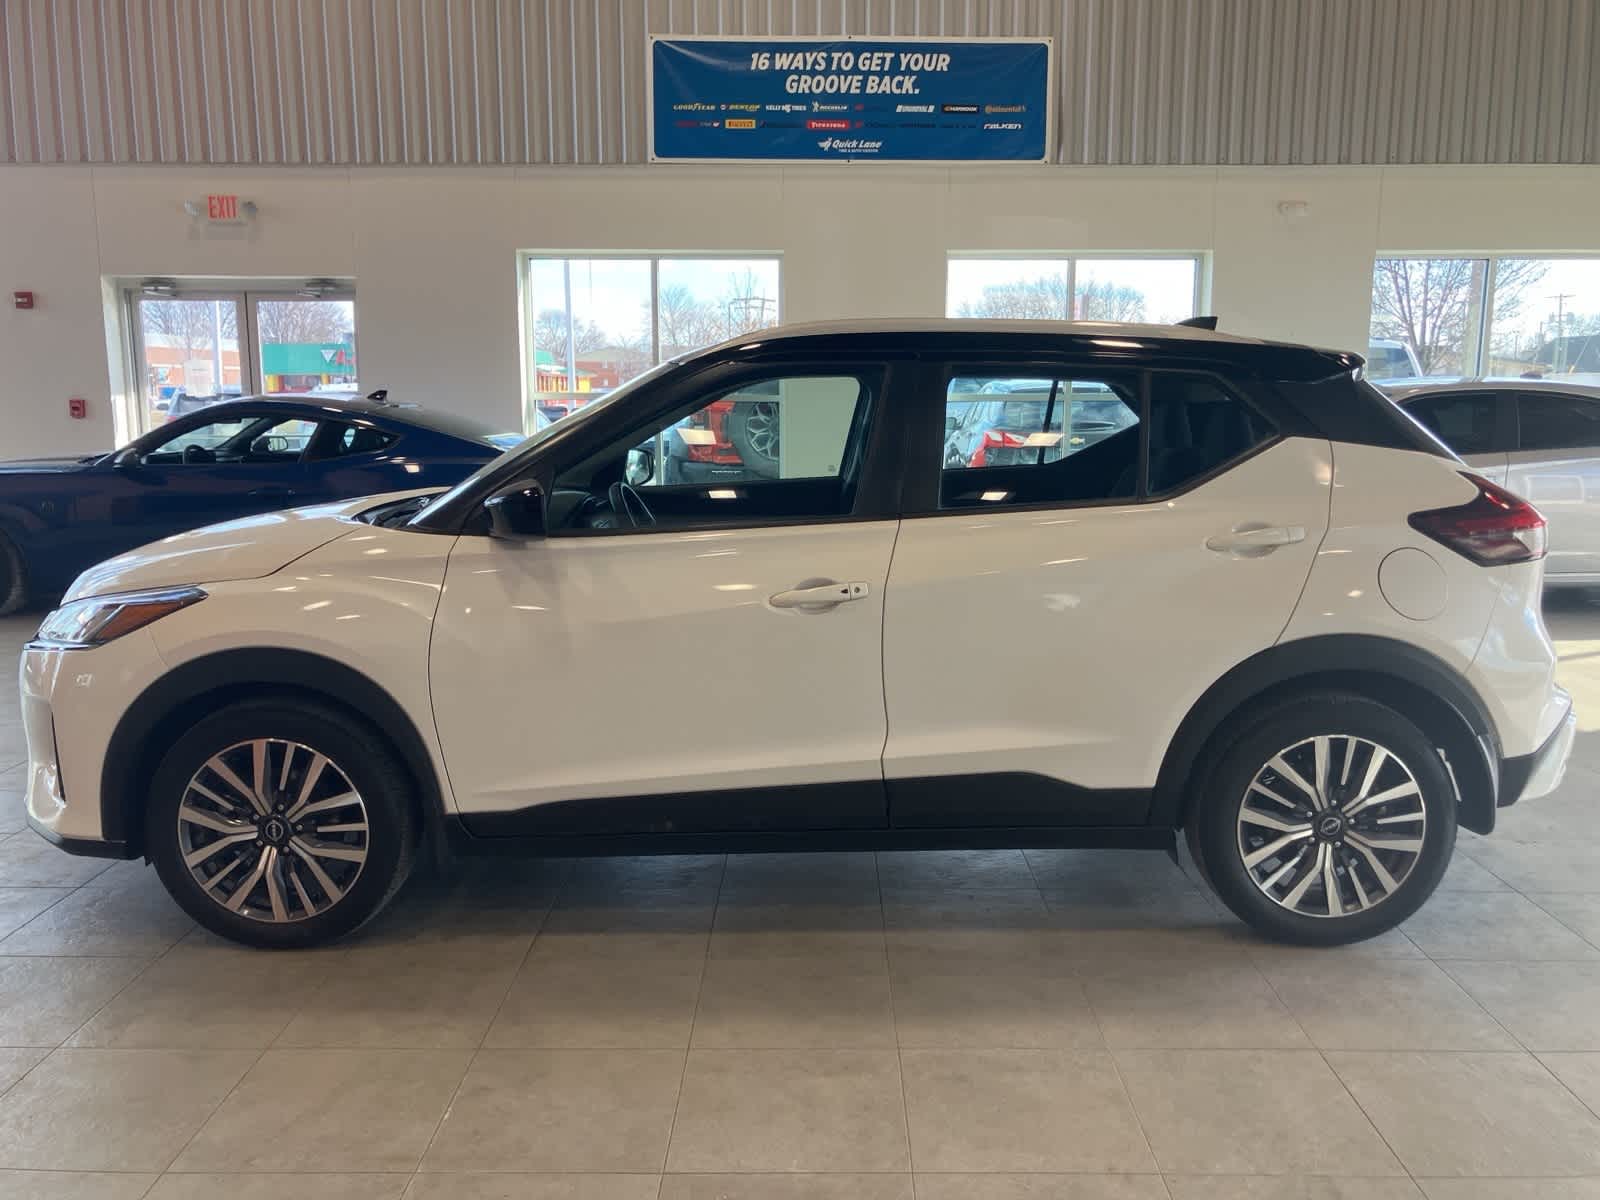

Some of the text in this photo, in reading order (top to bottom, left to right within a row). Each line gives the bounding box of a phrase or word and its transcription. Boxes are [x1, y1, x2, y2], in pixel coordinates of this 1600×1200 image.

[751, 52, 950, 72] 16 WAYS TO GET YOUR
[785, 75, 920, 95] GROOVE BACK.
[832, 139, 882, 149] Quick Lane
[208, 195, 238, 219] EXIT
